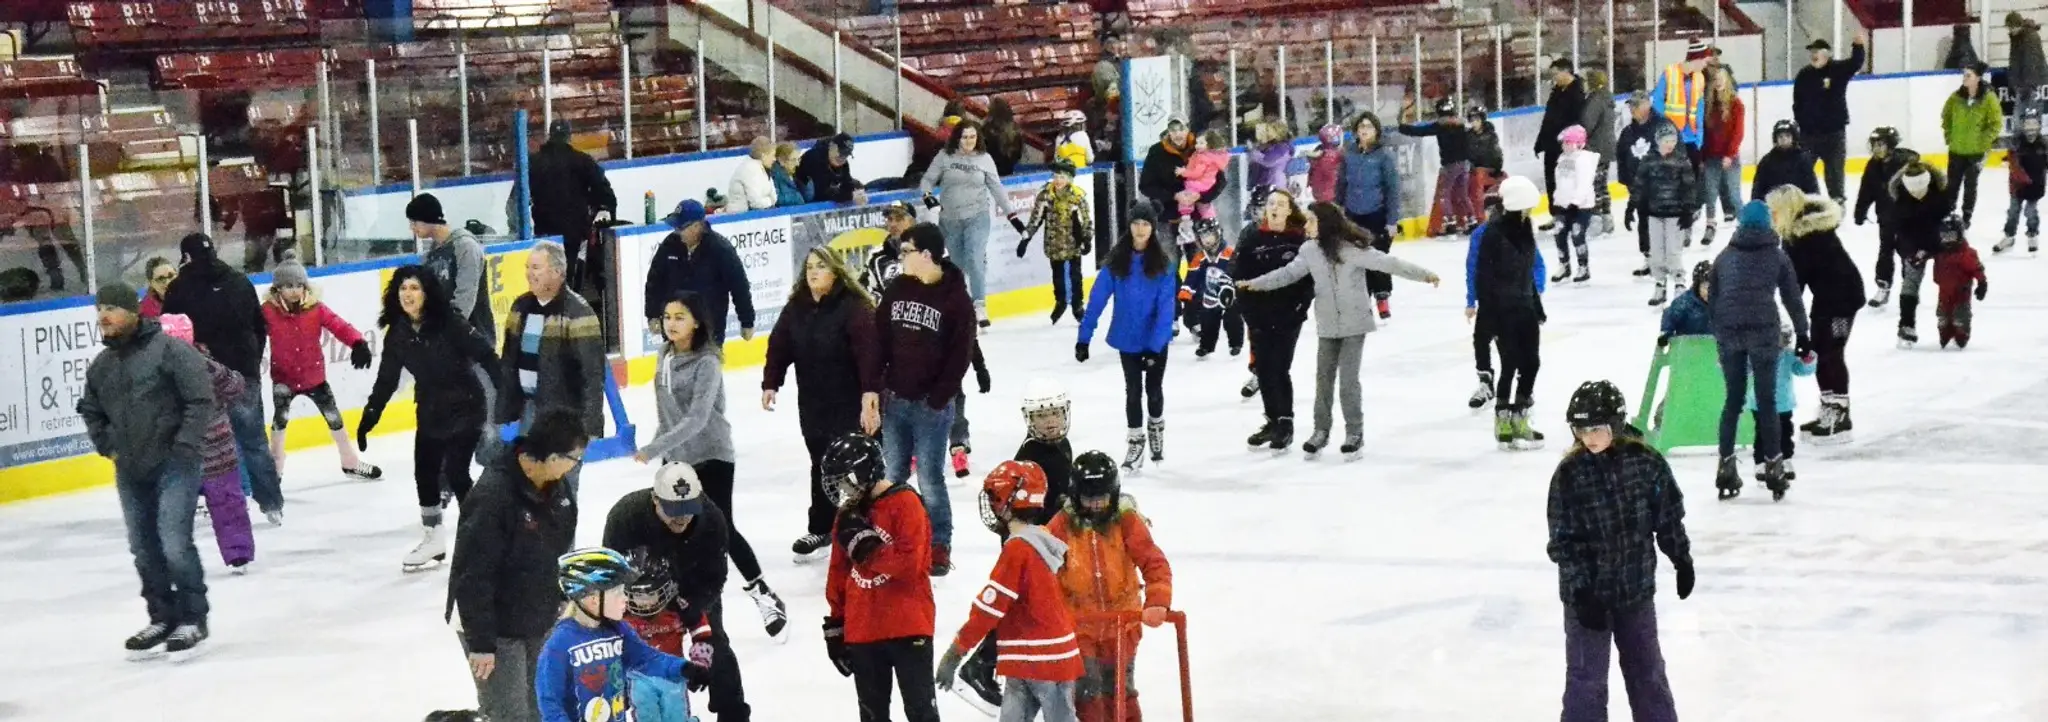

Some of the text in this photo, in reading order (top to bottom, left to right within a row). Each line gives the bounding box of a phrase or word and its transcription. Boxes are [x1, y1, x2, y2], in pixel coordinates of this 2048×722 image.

[823, 214, 863, 233] VALLEY
[726, 228, 787, 250] ORTGAGE
[891, 300, 941, 331] CAMBRIAN
[40, 376, 59, 410] &
